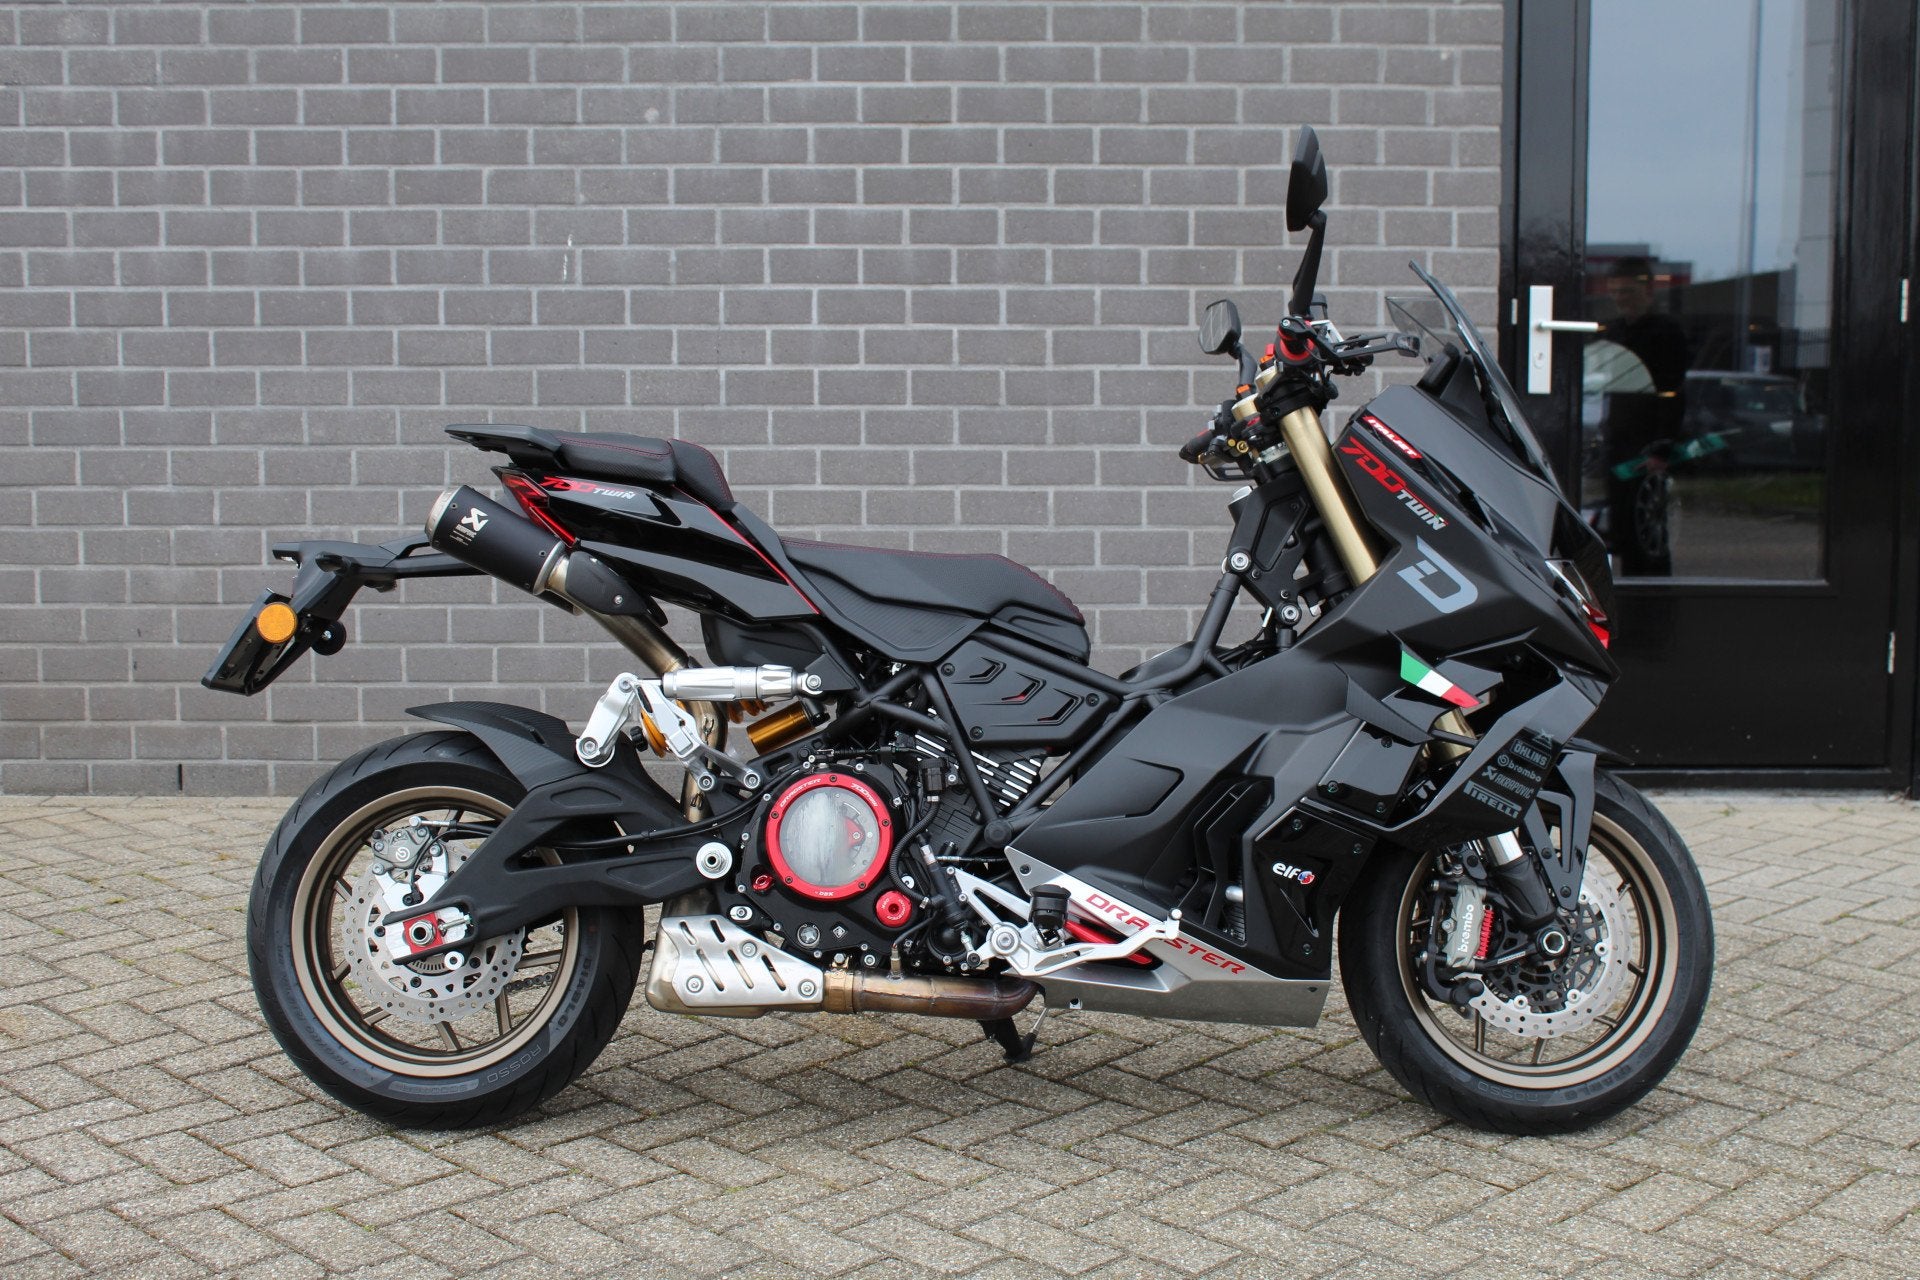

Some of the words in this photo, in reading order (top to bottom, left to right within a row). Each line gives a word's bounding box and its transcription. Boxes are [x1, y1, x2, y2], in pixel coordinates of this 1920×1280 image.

[1366, 418, 1418, 456] ITALJET
[593, 487, 635, 499] TWIN
[1340, 436, 1407, 493] 700
[1397, 489, 1447, 531] TWIN
[1508, 760, 1541, 782] brembo
[1463, 780, 1522, 819] PIRELLI
[1272, 862, 1302, 879] elf
[1086, 893, 1246, 974] DRASTER
[1457, 904, 1475, 953] brembo
[487, 1044, 542, 1083] ROSSO
